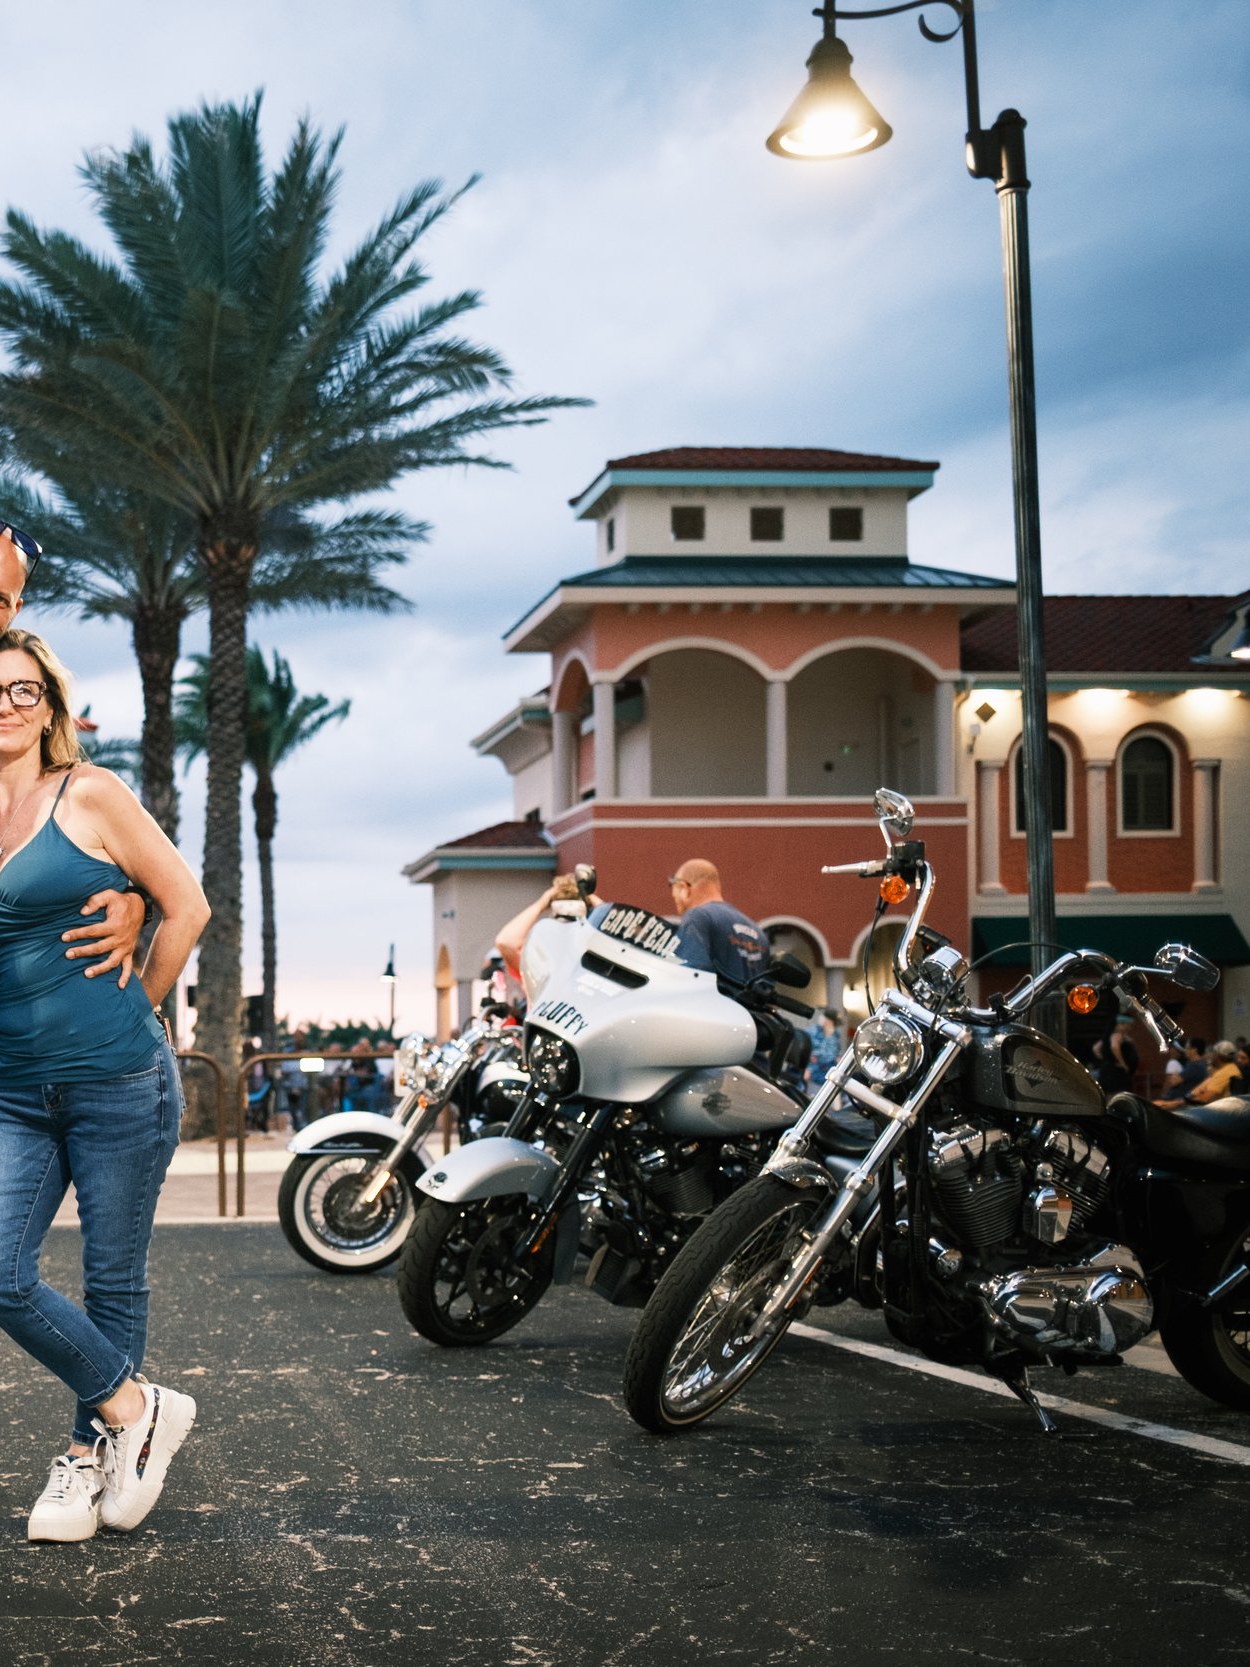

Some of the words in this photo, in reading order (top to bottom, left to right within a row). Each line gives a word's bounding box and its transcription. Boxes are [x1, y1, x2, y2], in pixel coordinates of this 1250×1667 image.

[599, 908, 646, 940] CAPE
[634, 915, 682, 957] FEAR
[532, 999, 590, 1036] FLUFFY
